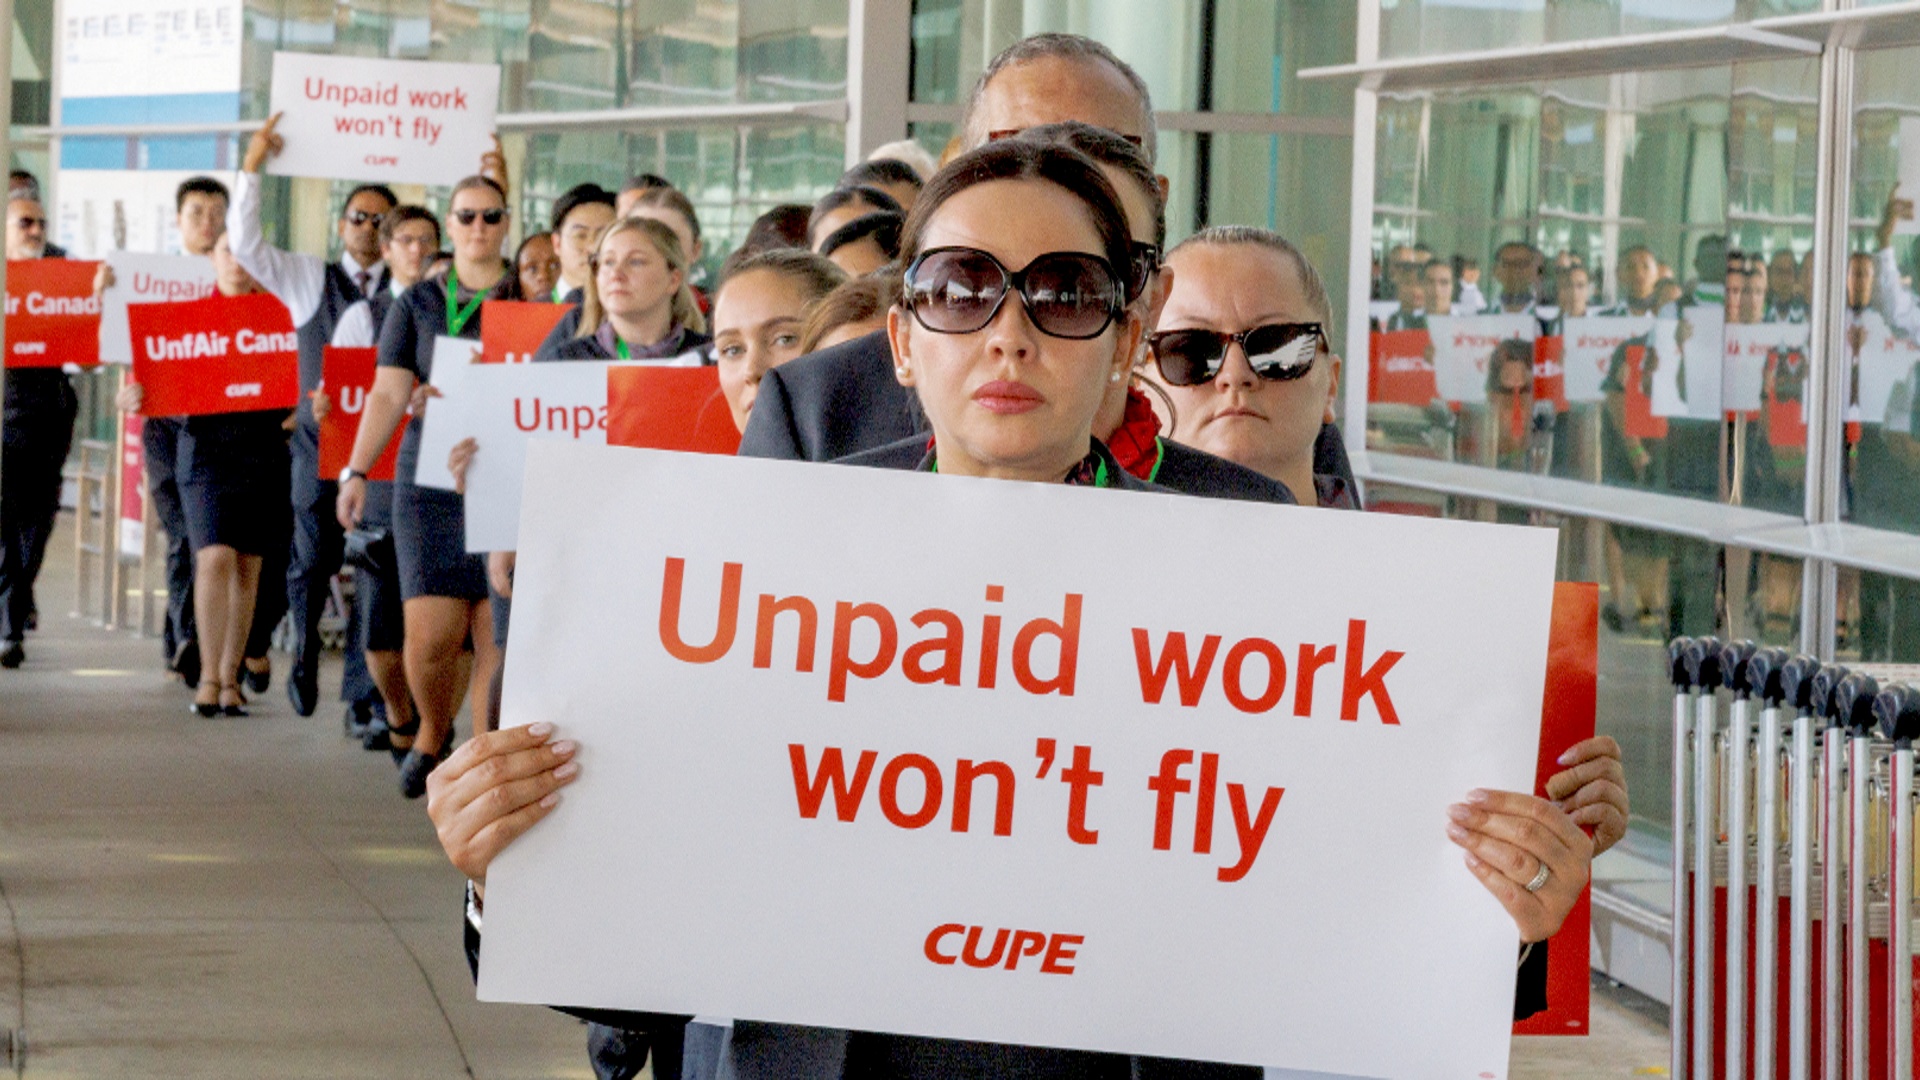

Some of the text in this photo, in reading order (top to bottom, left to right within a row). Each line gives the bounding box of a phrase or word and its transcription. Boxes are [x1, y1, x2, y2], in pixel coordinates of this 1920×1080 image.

[304, 76, 467, 110] Unpaid work
[334, 114, 443, 145] won't fly
[145, 328, 298, 361] UnfAir Cana
[659, 557, 1405, 726] Unpaid work
[1147, 748, 1285, 883] fly
[923, 923, 1085, 975] CUPE
